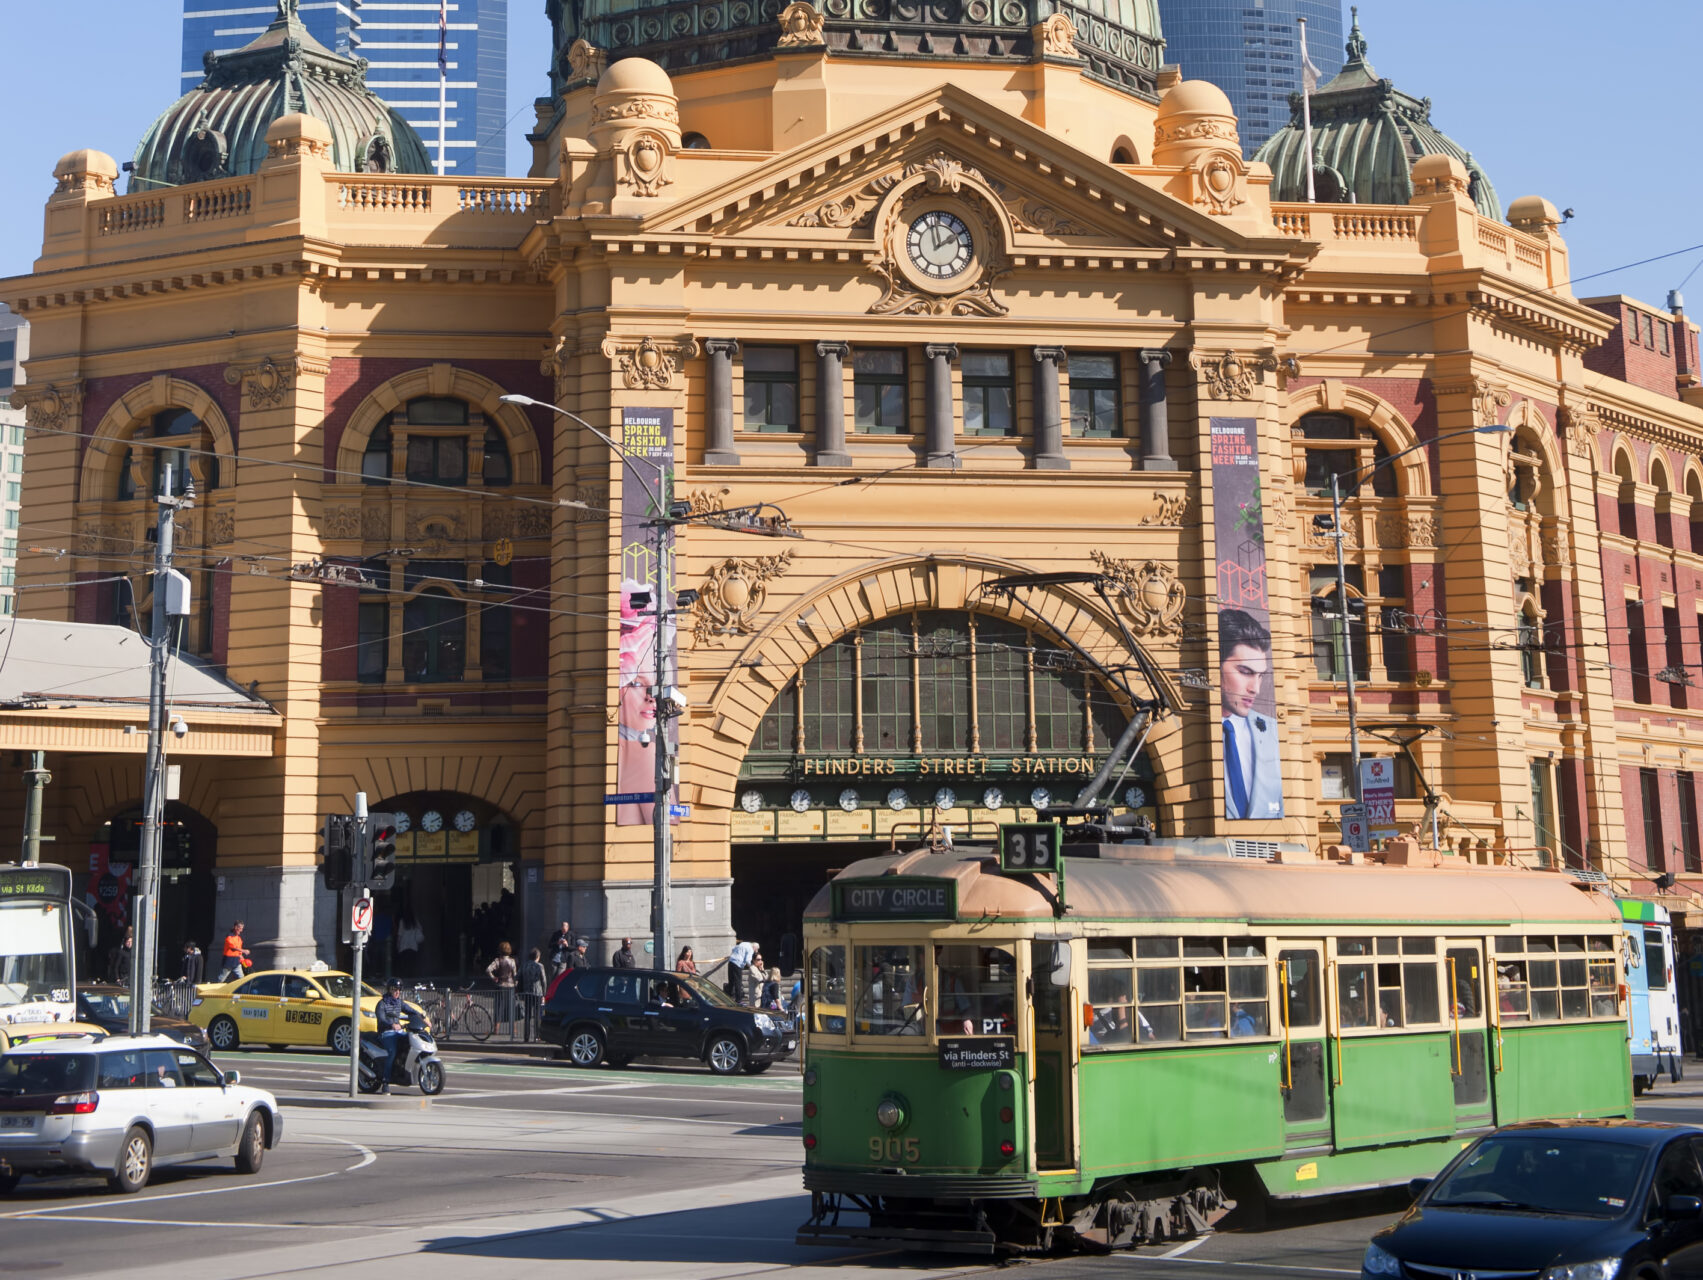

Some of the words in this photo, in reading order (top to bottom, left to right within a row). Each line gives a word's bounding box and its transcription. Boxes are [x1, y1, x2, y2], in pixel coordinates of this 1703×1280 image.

[624, 417, 660, 425] MELBOURNE
[624, 425, 661, 436] SPRING
[624, 436, 667, 447] FASHION
[1212, 434, 1246, 444] SPRING
[624, 446, 648, 457] WEEK
[1212, 445, 1252, 455] FASHION
[1212, 455, 1235, 465] WEEK
[804, 758, 895, 775] FLINDERS
[920, 758, 988, 774] STREET
[1011, 757, 1094, 774] STATION
[605, 794, 633, 802] Swanston
[1367, 805, 1393, 818] DAY
[1011, 833, 1049, 866] 35
[1, 885, 13, 894] via
[16, 884, 24, 893] St
[26, 883, 45, 893] Kilda
[851, 889, 886, 907] CITY
[892, 888, 945, 907] CIRCLE
[51, 989, 70, 1002] 3503
[285, 1010, 322, 1025] 13CABS
[983, 1018, 1004, 1034] PT
[943, 1051, 958, 1060] via
[960, 1050, 997, 1060] Flinders
[999, 1050, 1009, 1060] St
[869, 1136, 920, 1162] 905
